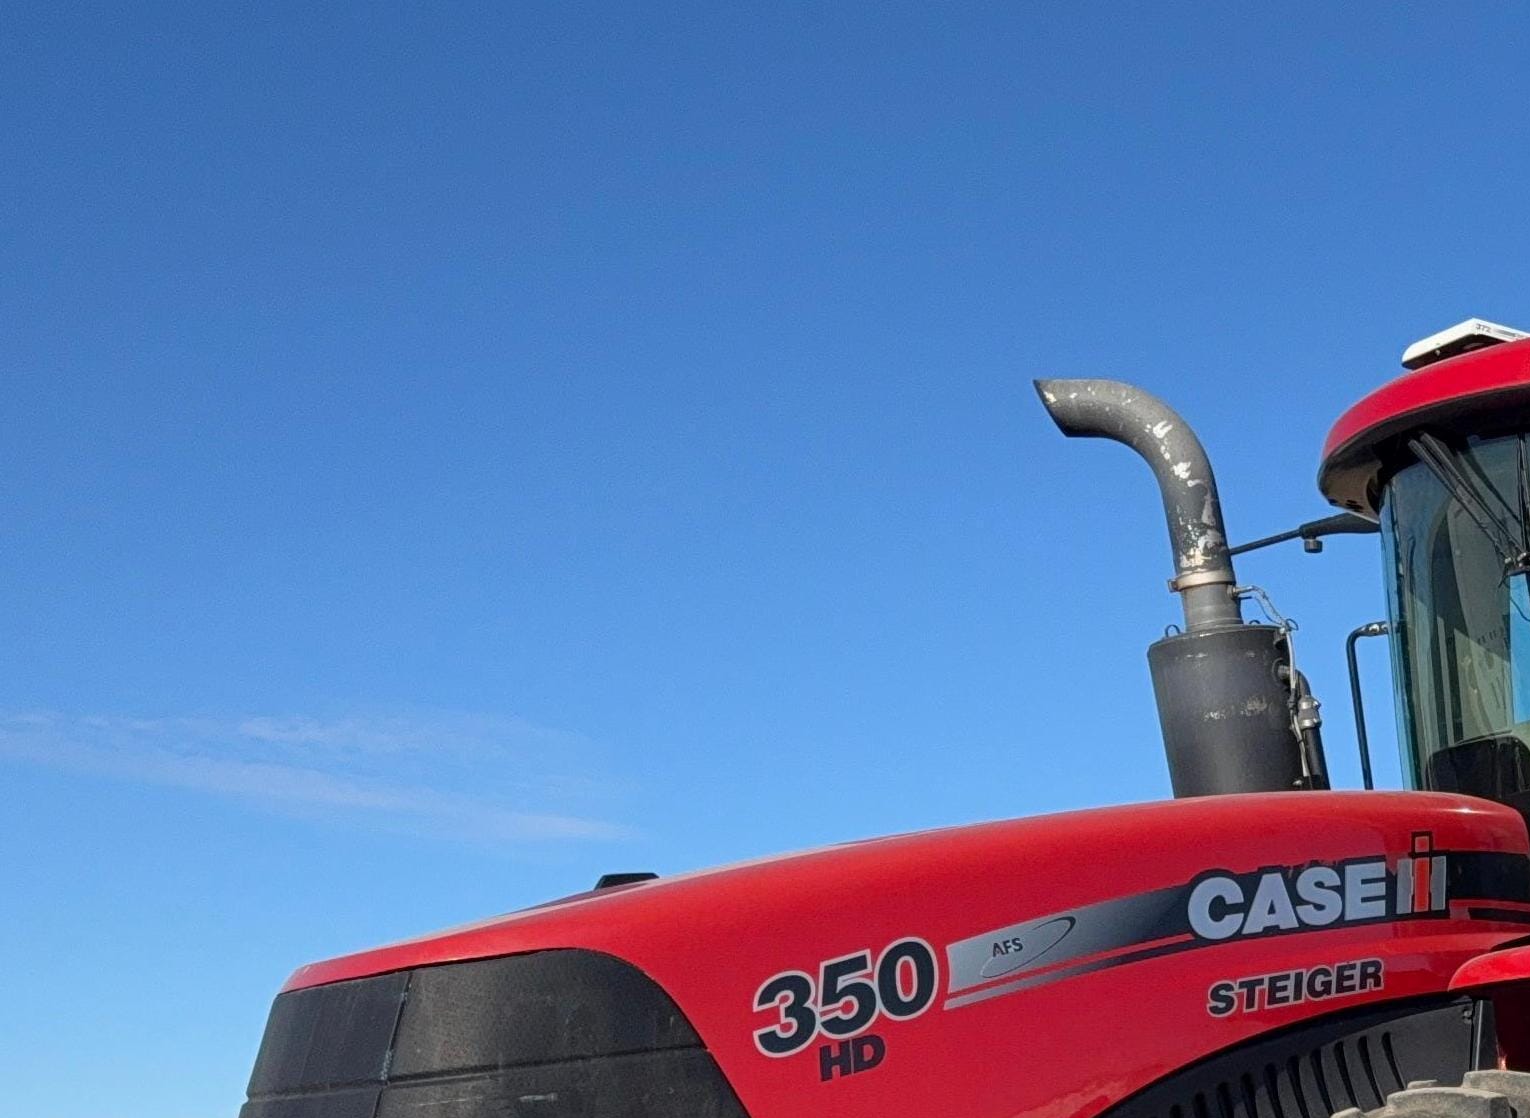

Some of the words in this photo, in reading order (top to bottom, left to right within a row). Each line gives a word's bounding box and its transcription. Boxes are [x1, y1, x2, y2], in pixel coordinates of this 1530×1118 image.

[1188, 861, 1386, 940] CASE
[992, 938, 1023, 957] AFS
[753, 936, 939, 1058] 350
[1207, 957, 1384, 1017] STEIGER
[819, 1034, 886, 1082] HD
